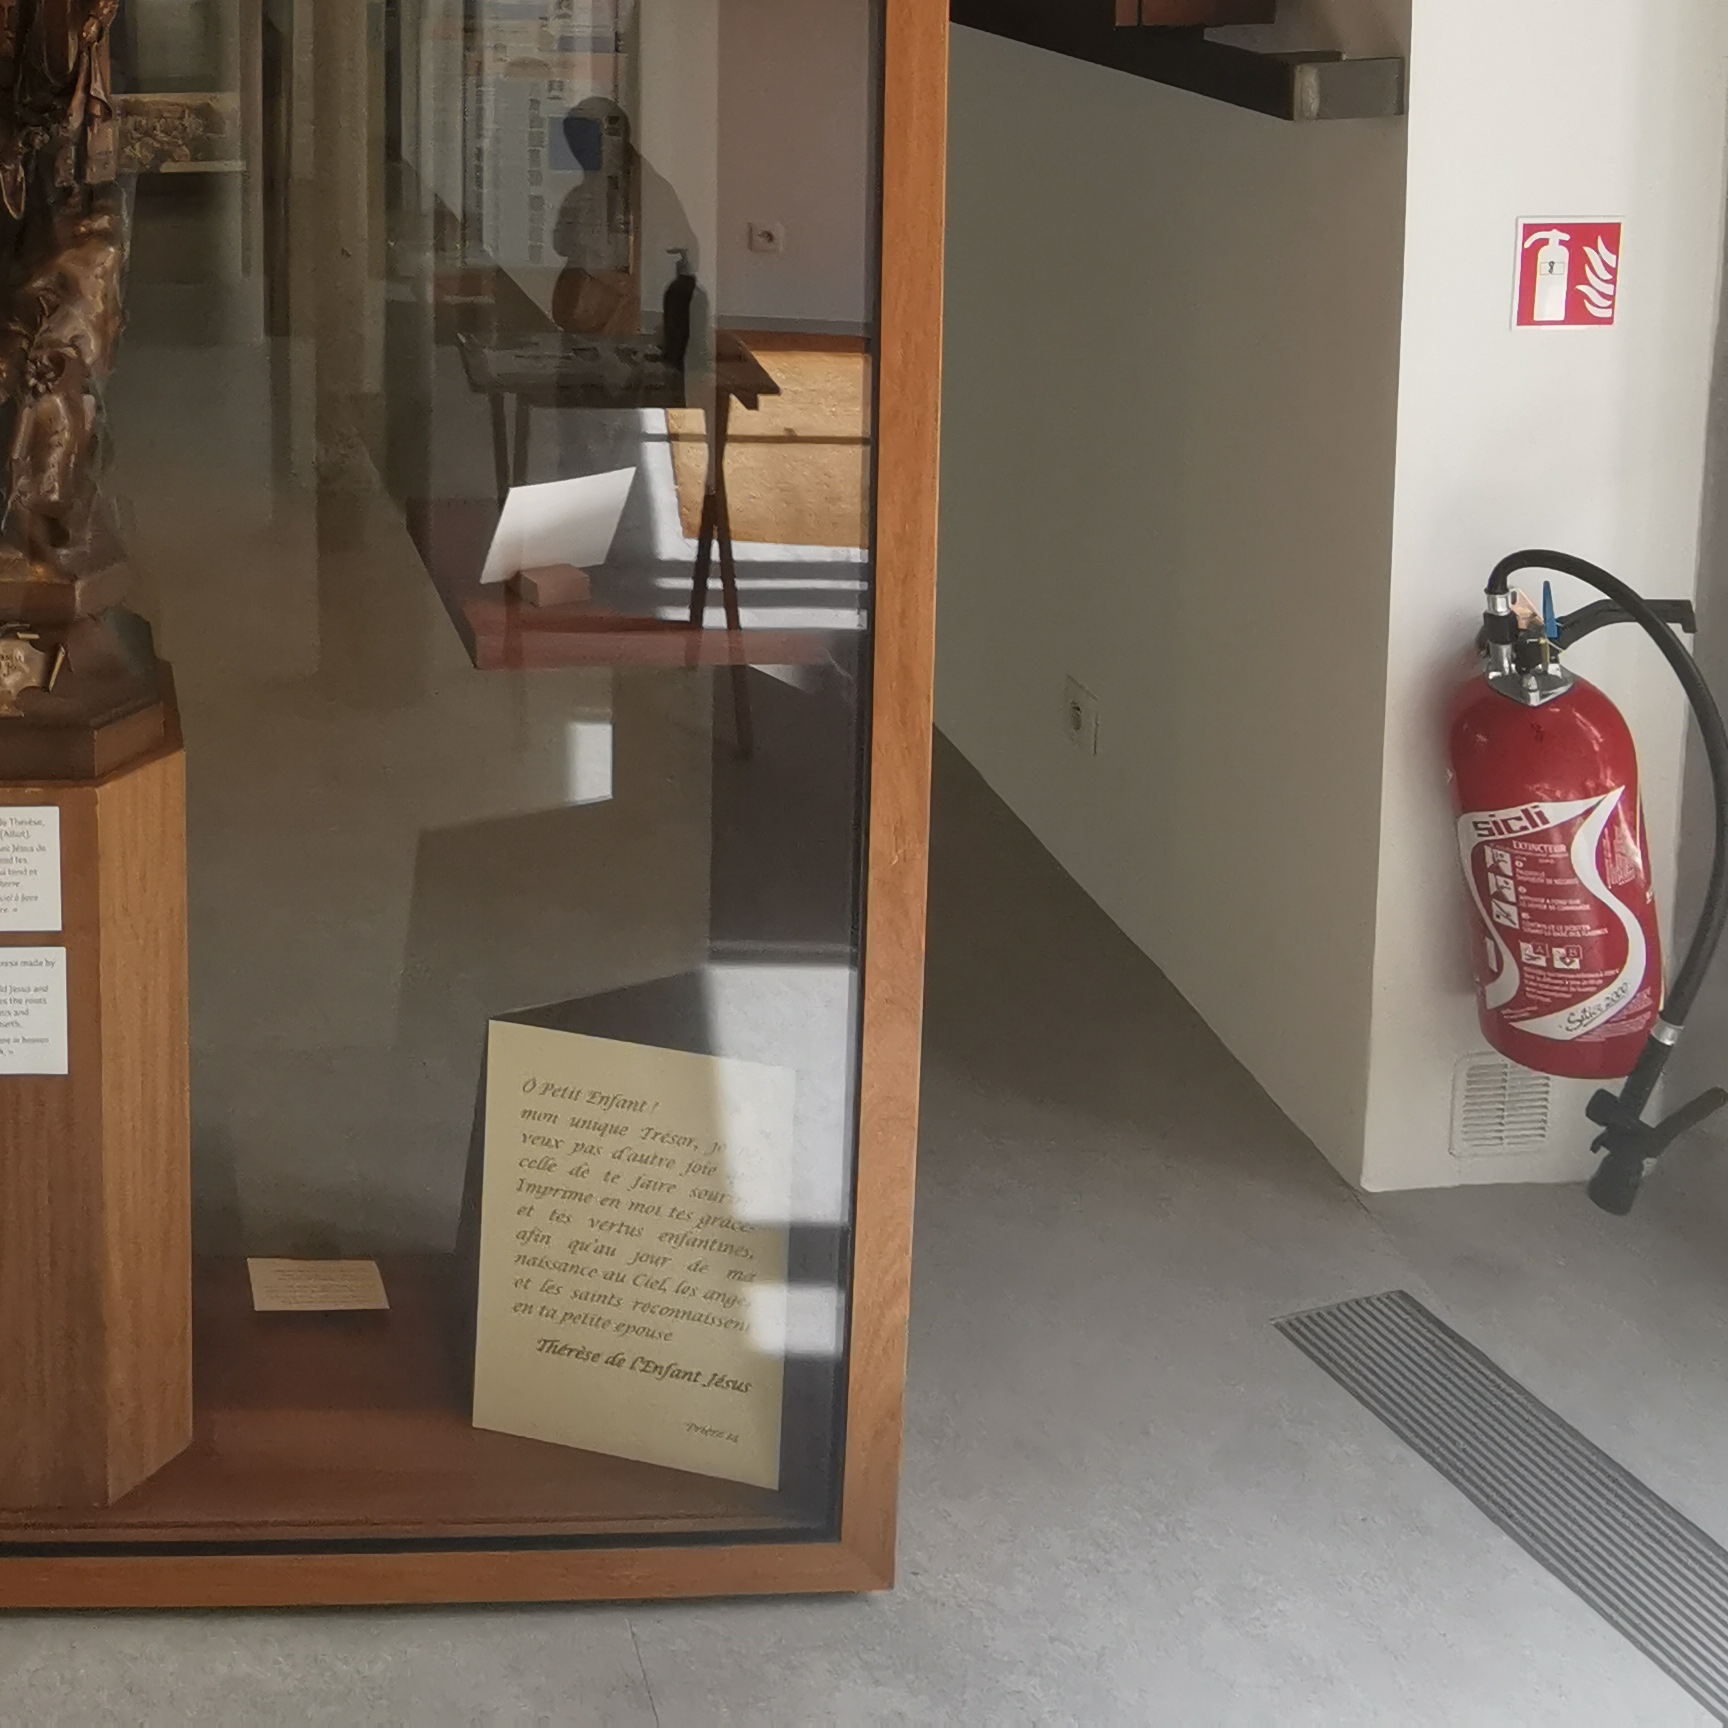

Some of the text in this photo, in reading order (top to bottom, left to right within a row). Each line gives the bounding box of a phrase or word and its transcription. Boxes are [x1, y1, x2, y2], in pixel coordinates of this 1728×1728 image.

[1472, 804, 1551, 838] sicli
[539, 1081, 583, 1101] Petit
[586, 1090, 647, 1113] Enfant
[520, 1108, 559, 1124] mon
[569, 1116, 630, 1138] unique
[522, 1132, 717, 1177] veux pas d'autre joie
[518, 1155, 677, 1193] celle de te faire
[516, 1177, 594, 1200] Imprime
[599, 1196, 621, 1210] en
[628, 1199, 661, 1216] moi
[668, 1206, 693, 1221] tes
[517, 1205, 534, 1218] et
[549, 1208, 572, 1225] tes
[589, 1217, 645, 1238] vertus
[515, 1227, 757, 1283] afin qu'au jour de ma
[514, 1253, 599, 1278] naissance
[602, 1270, 626, 1284] au
[674, 1279, 699, 1297] les
[514, 1277, 532, 1290] et
[538, 1278, 563, 1295] les
[570, 1289, 624, 1307] saints
[512, 1302, 534, 1315] en
[537, 1305, 558, 1319] ta
[555, 1311, 612, 1330] petite
[536, 1338, 752, 1393] Thérèse de l'Enfant Jésus
